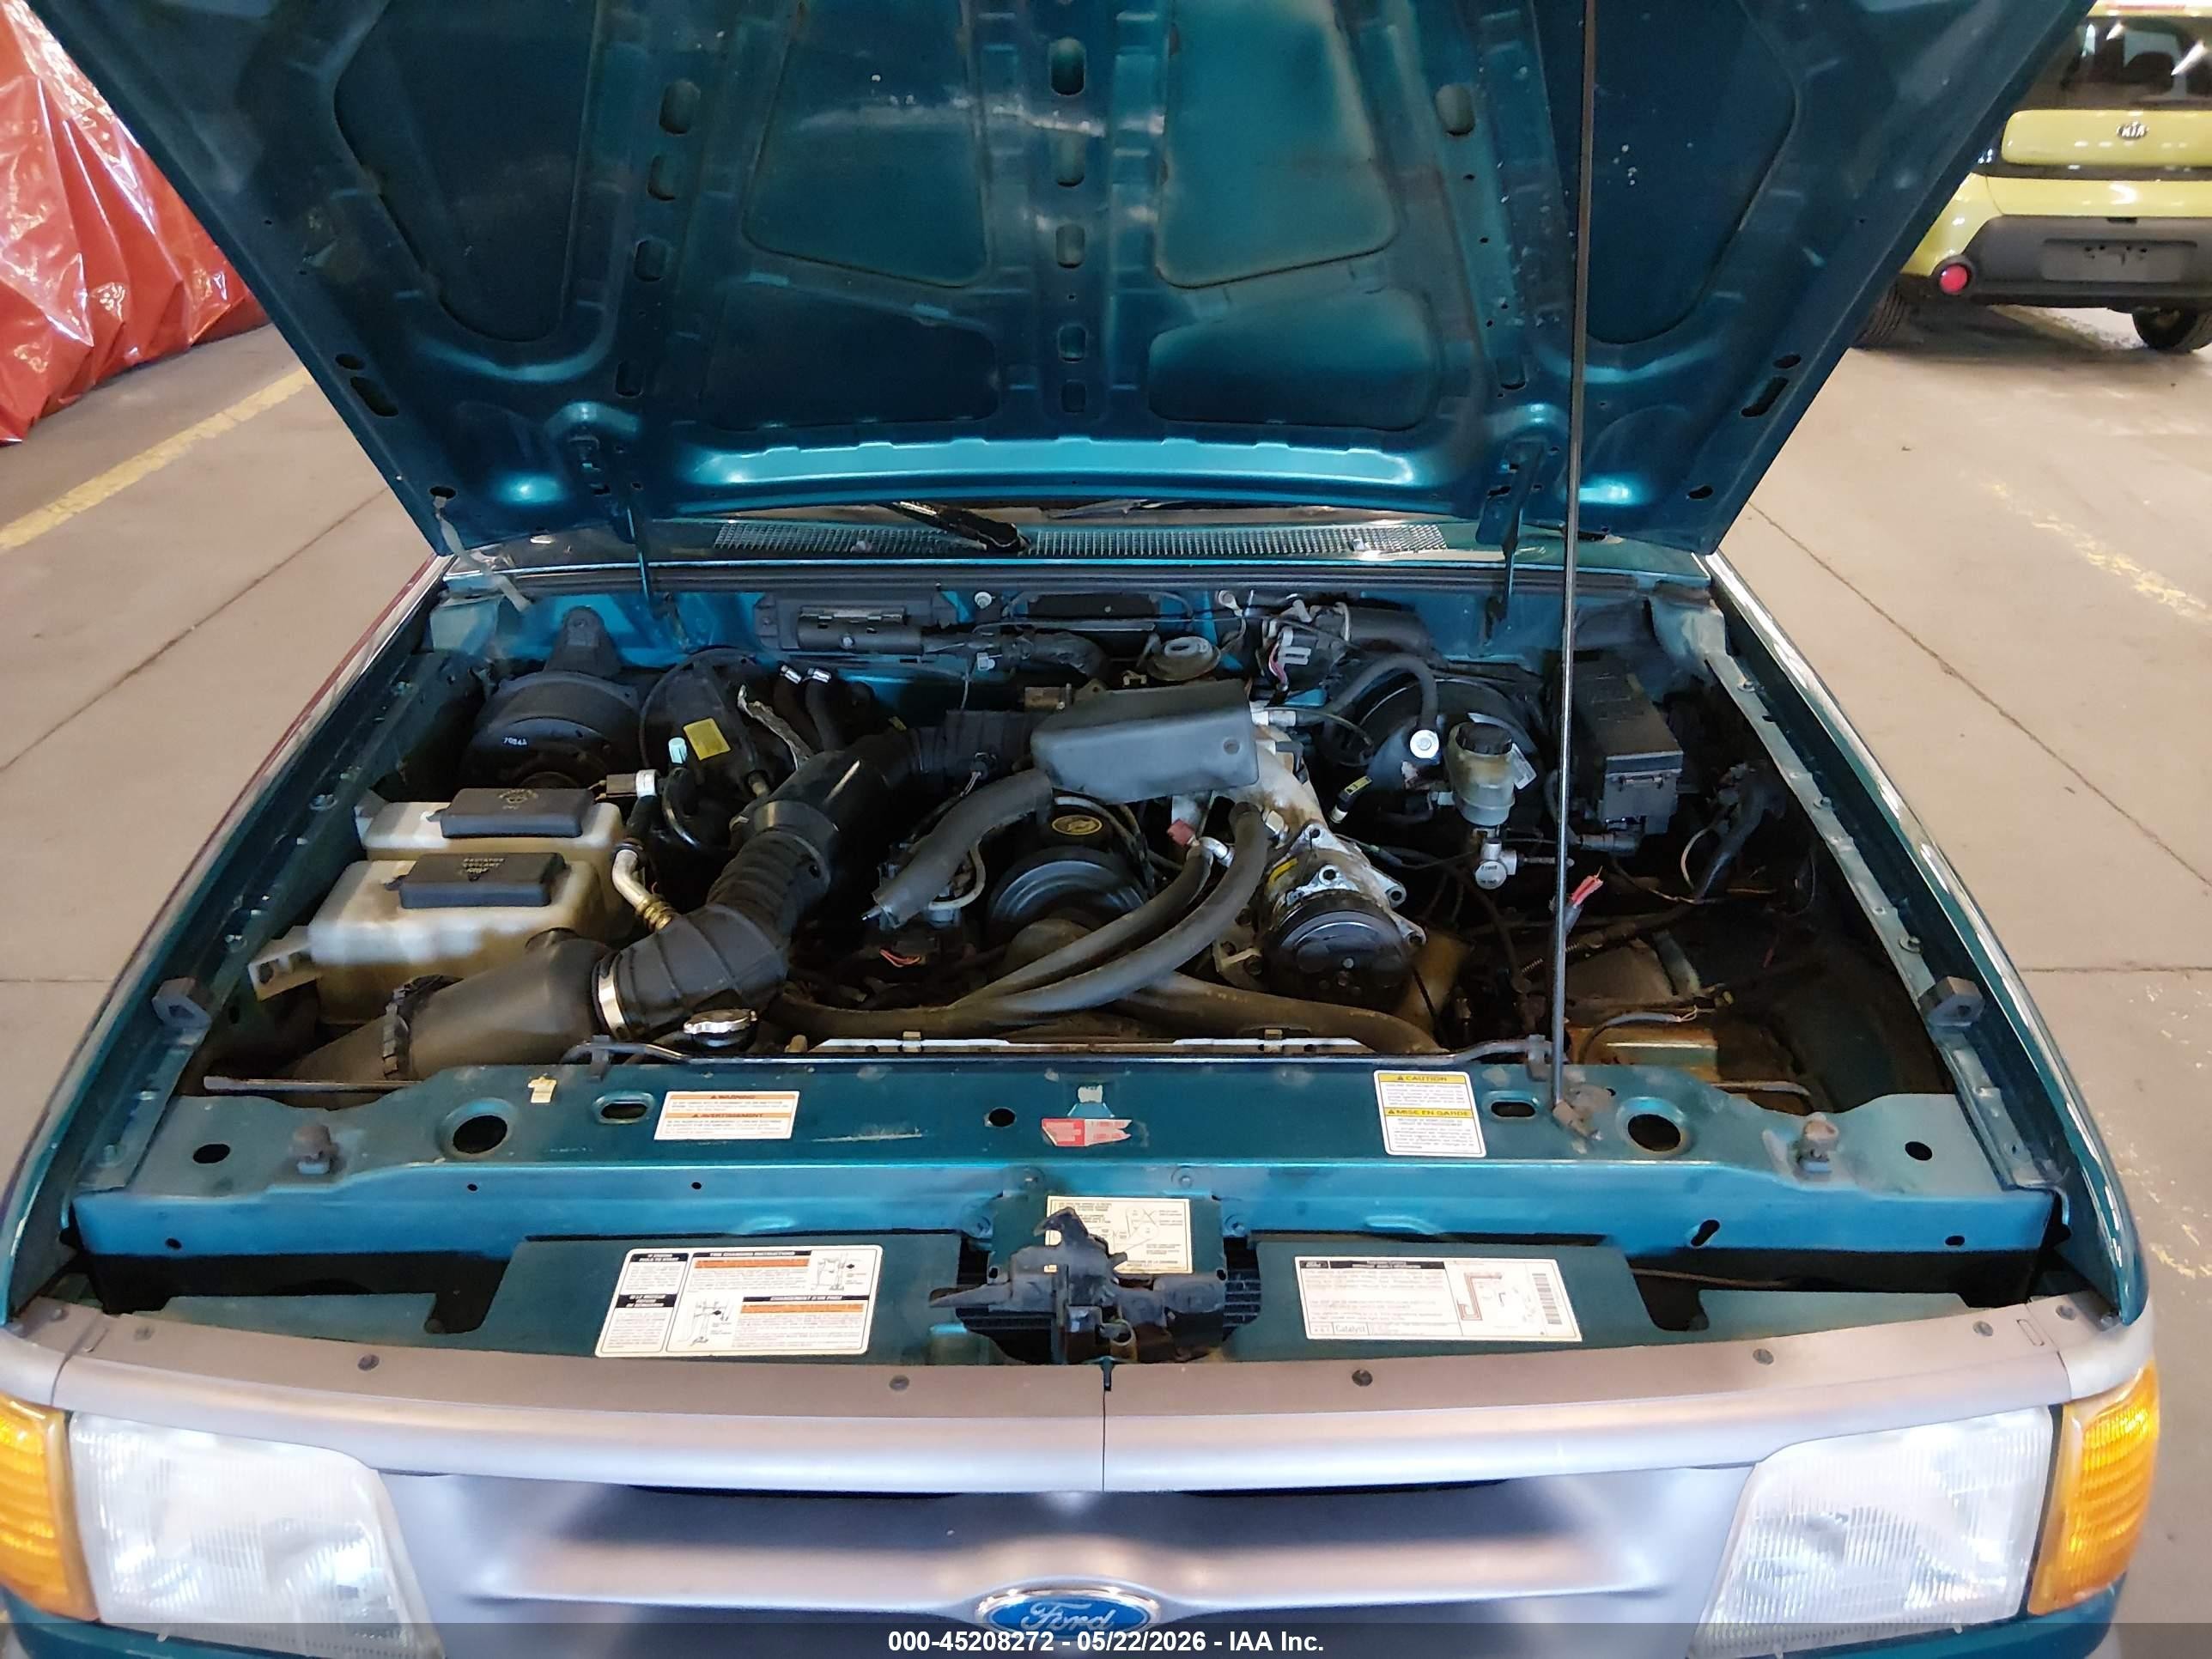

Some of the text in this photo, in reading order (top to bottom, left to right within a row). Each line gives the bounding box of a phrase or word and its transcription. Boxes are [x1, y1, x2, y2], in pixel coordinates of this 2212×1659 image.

[2121, 120, 2145, 137] KIA
[1335, 1323, 1366, 1333] Catalyst
[1020, 1601, 1116, 1631] Ford
